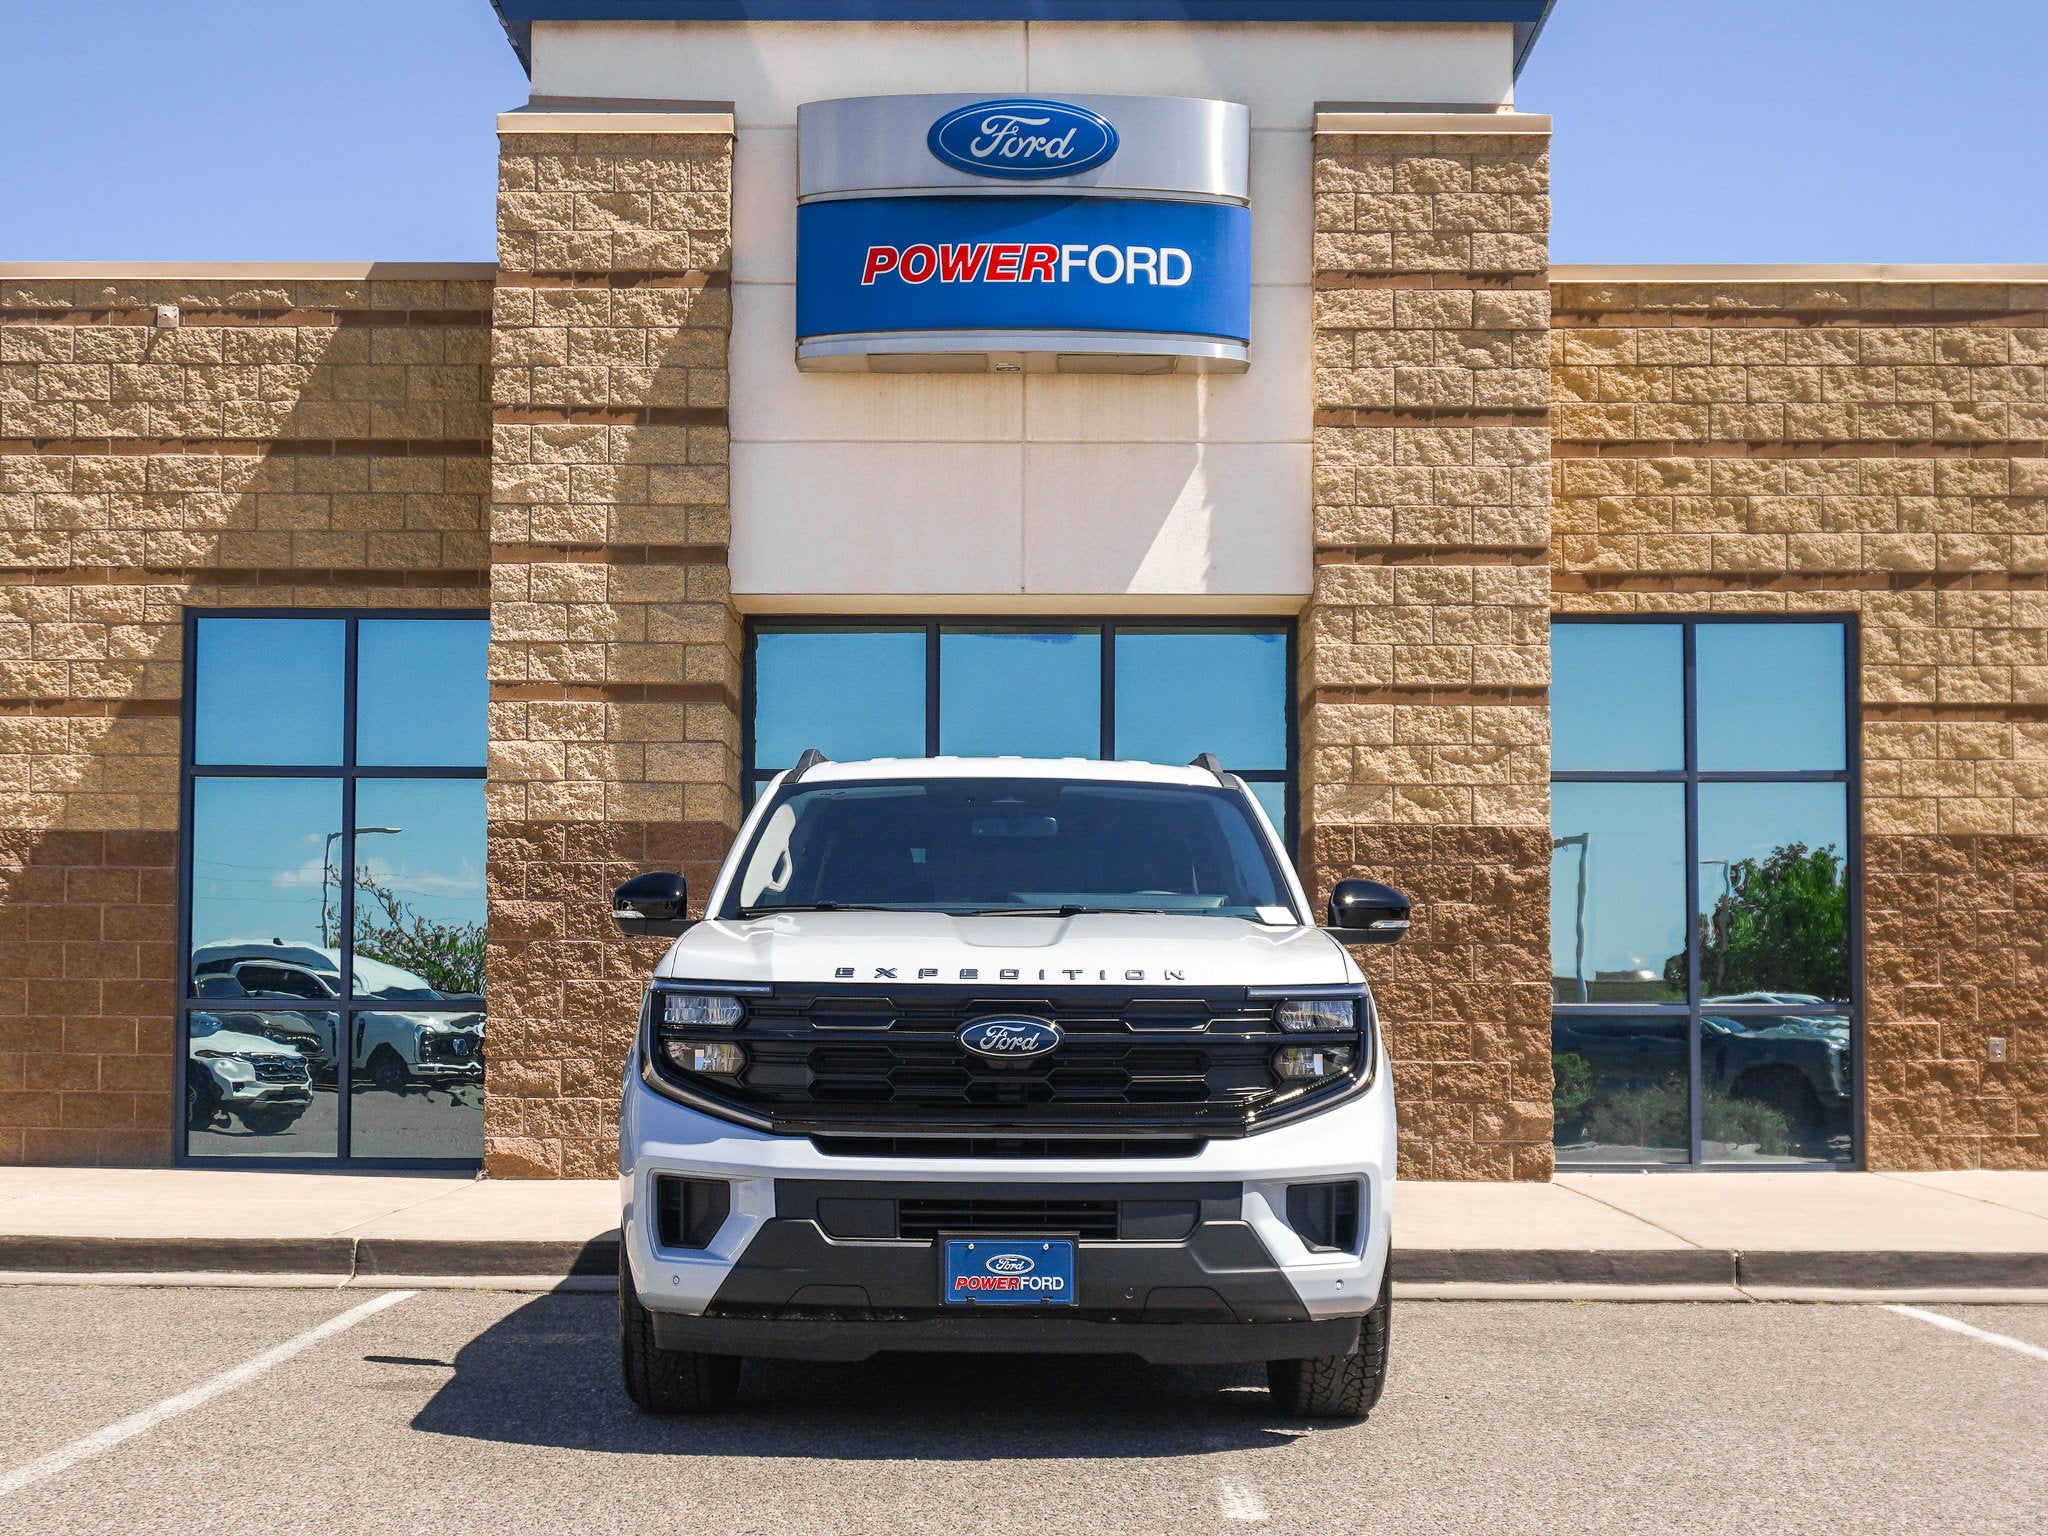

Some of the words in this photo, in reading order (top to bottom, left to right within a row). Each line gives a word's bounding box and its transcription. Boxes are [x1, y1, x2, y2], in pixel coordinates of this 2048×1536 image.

[970, 114, 1077, 160] Ford
[834, 967, 1185, 981] EXPEDITION
[979, 1025, 1040, 1052] Ford
[996, 1258, 1024, 1271] Ford
